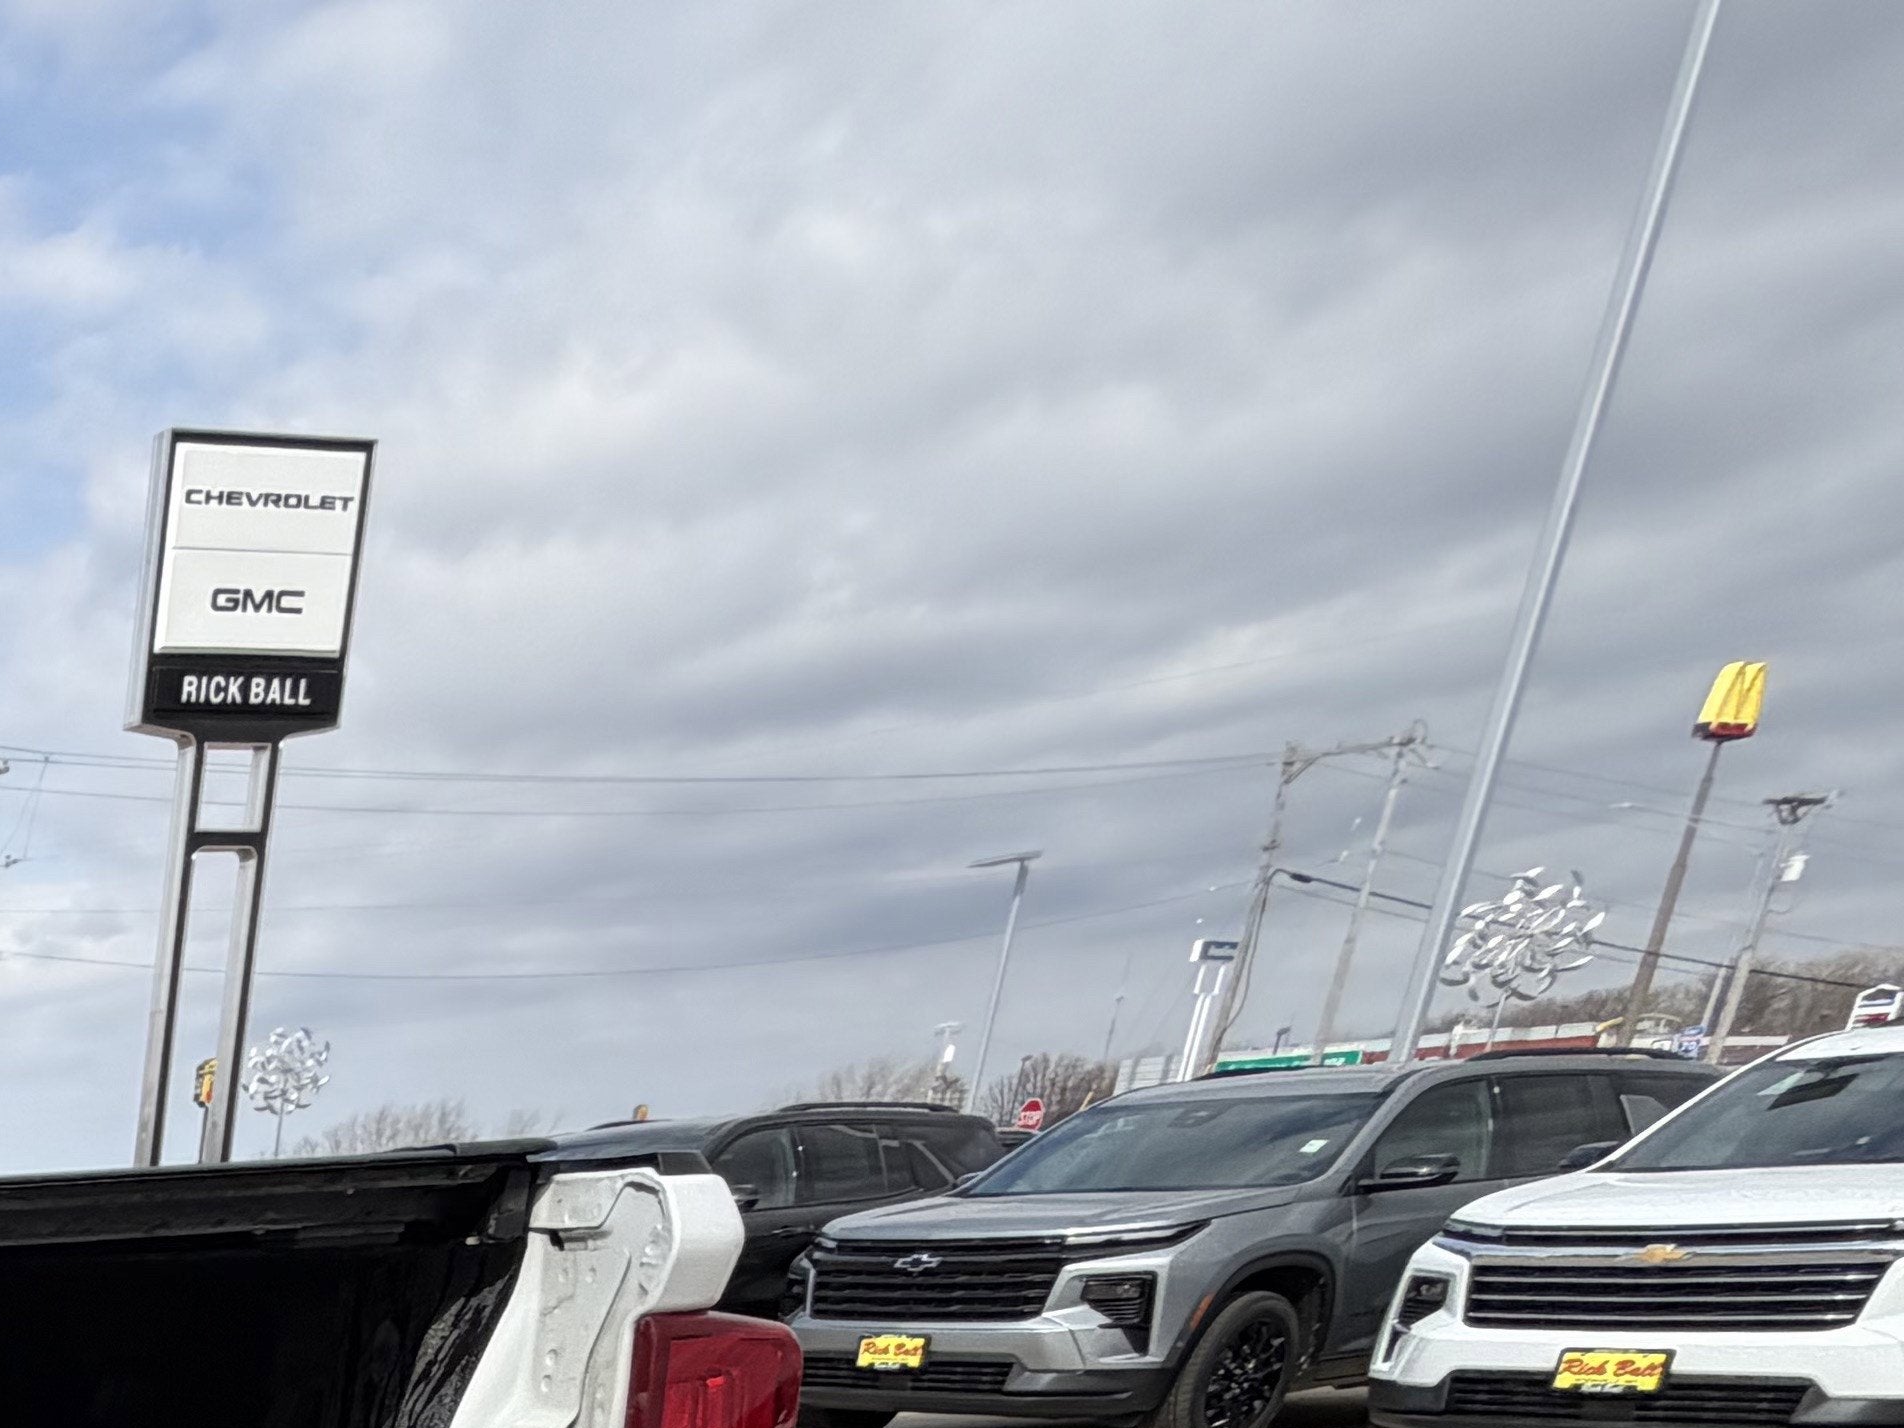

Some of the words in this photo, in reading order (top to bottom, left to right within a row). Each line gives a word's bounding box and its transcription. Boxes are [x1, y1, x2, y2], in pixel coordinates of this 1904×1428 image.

[184, 488, 354, 512] CHEVROLET
[210, 587, 305, 615] GMC
[180, 674, 245, 704] RICK
[248, 678, 312, 706] BALL
[1558, 1358, 1609, 1376] Rick
